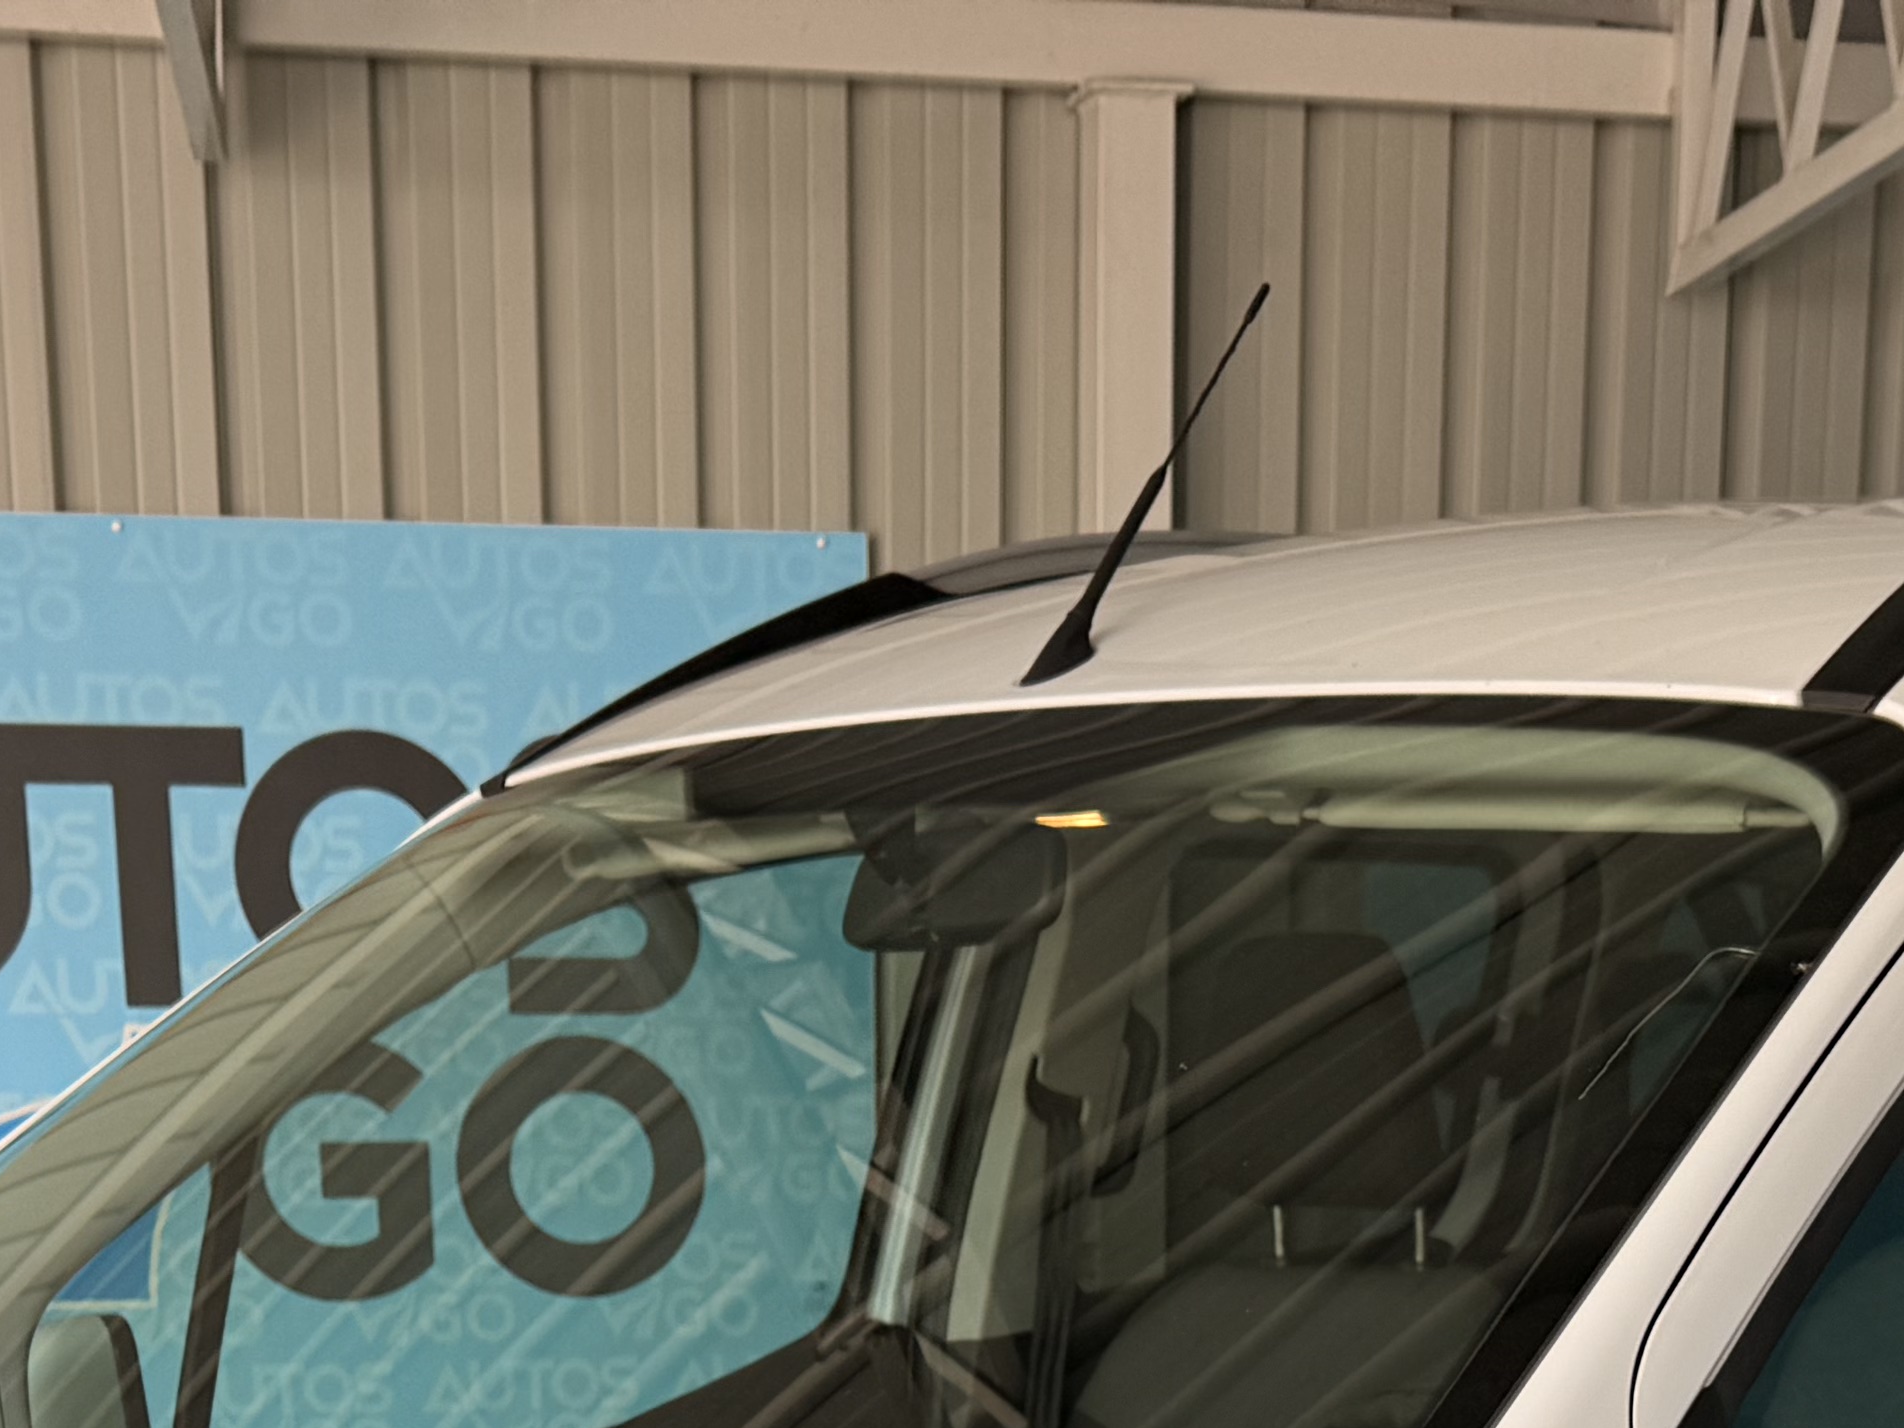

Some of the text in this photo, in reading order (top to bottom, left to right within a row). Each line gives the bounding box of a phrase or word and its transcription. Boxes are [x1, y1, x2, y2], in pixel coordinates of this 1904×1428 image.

[111, 527, 350, 586] AUTOS
[381, 531, 613, 593] AUTOS
[166, 587, 353, 649] VIGO
[434, 592, 614, 654] VIGO
